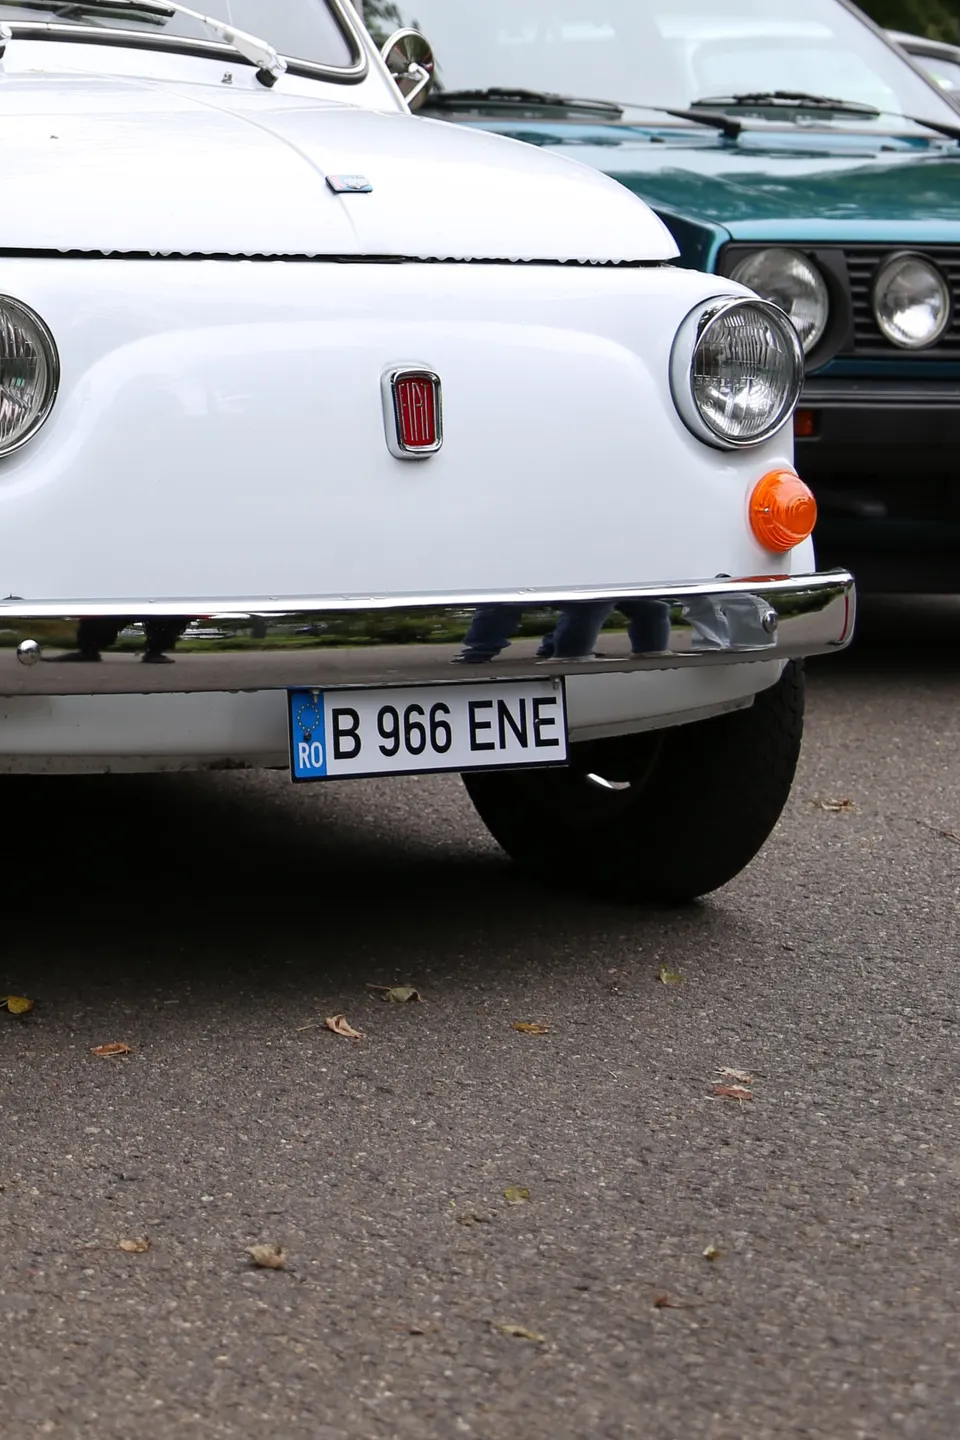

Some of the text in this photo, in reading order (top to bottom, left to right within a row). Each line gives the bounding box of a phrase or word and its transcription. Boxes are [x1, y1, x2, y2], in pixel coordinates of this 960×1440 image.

[399, 382, 429, 441] FIAT
[298, 741, 323, 769] RO
[332, 696, 560, 760] B 966 ENE
